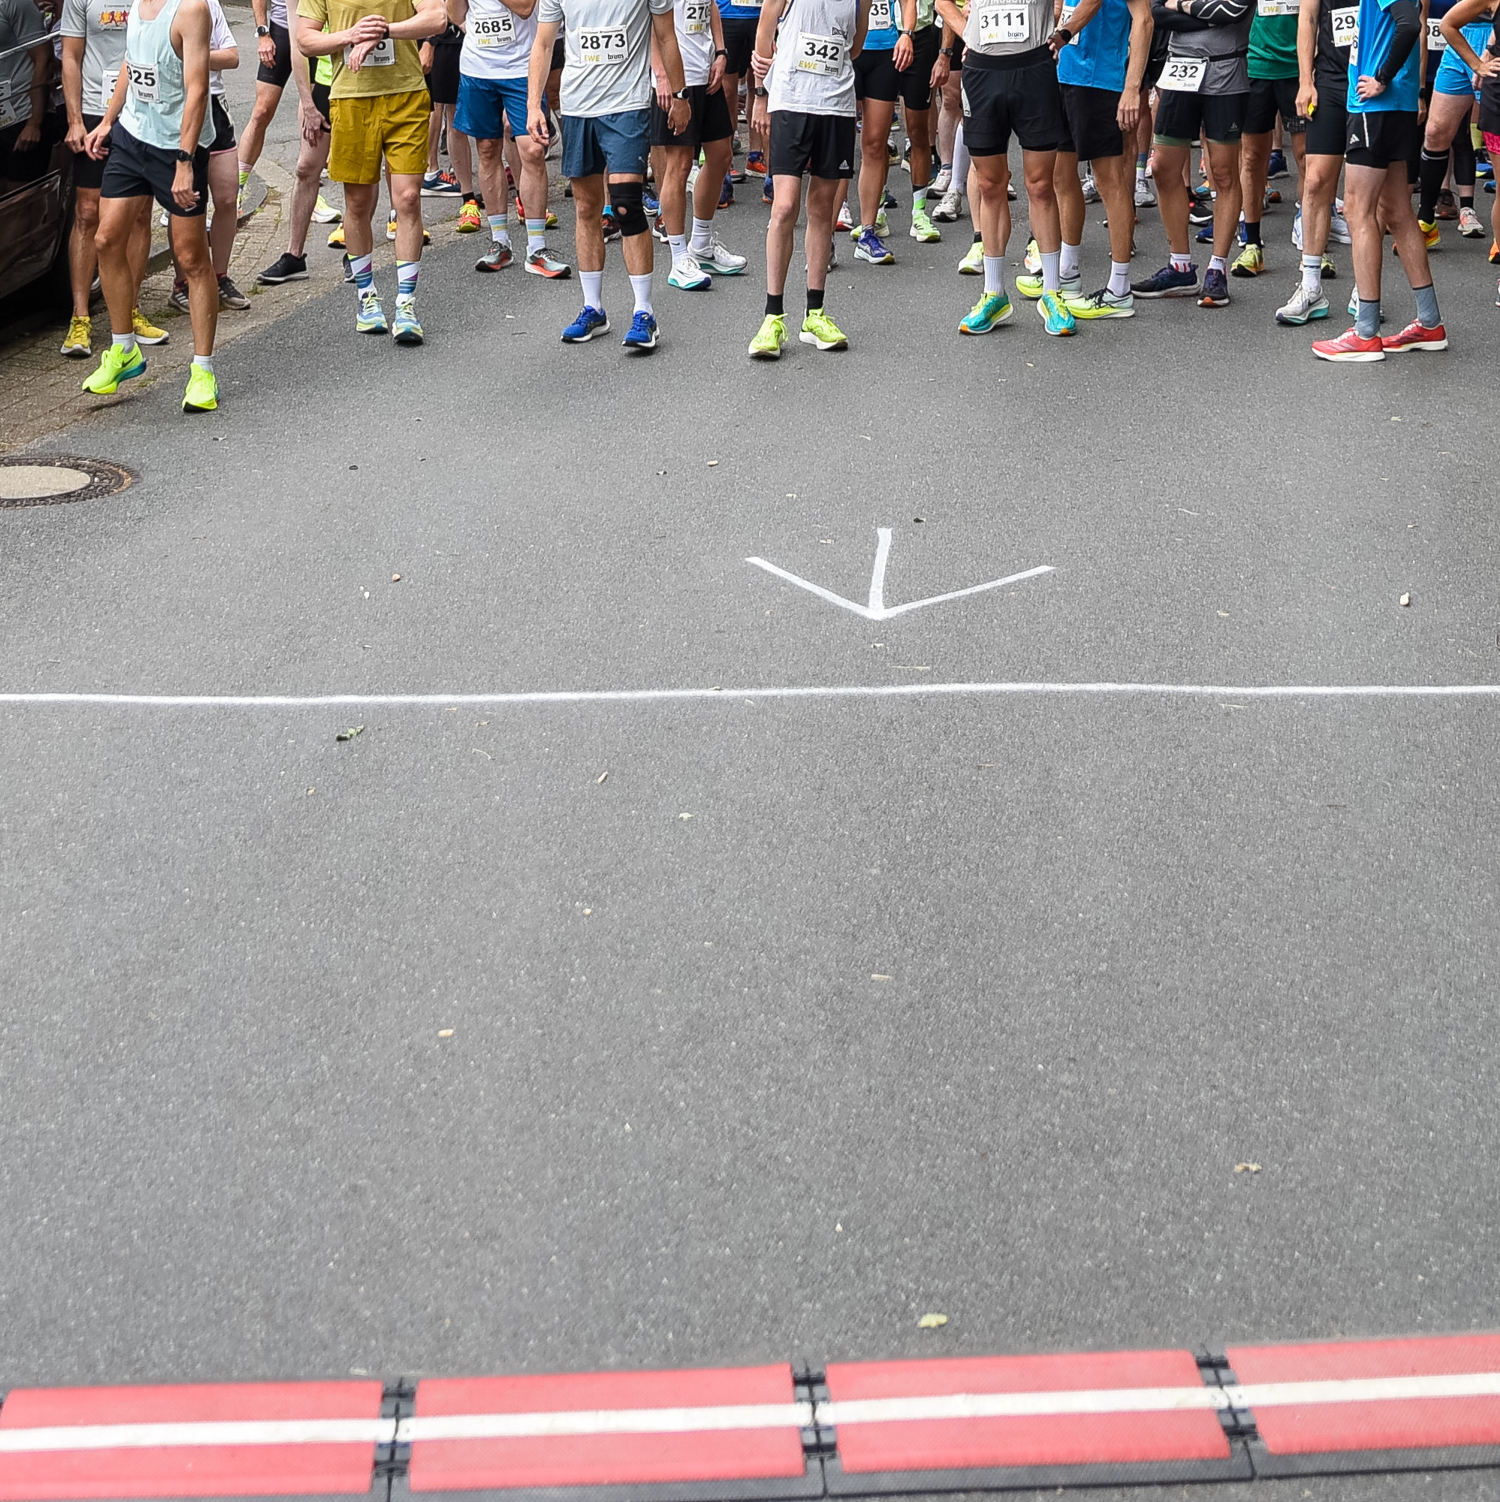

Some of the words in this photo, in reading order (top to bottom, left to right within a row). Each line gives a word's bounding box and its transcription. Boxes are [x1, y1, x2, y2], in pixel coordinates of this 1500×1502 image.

[474, 18, 512, 34] 2685
[980, 12, 1025, 29] 3111
[580, 33, 626, 49] 2873
[1339, 34, 1352, 43] EW
[804, 41, 840, 62] 342
[798, 60, 818, 70] EWE
[1168, 64, 1199, 79] 232
